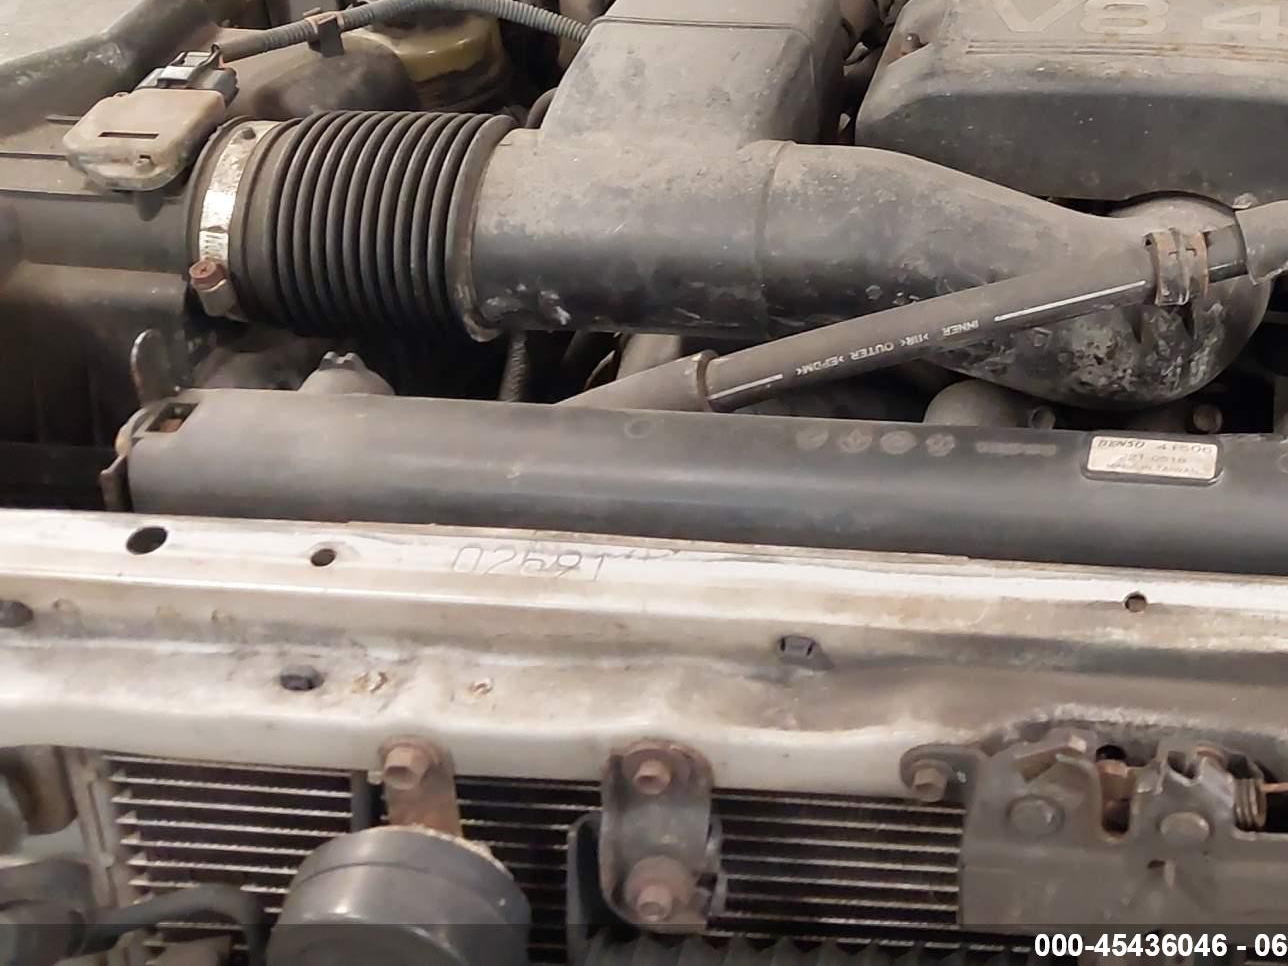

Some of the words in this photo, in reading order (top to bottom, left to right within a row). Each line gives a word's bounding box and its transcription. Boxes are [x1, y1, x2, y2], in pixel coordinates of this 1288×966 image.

[941, 319, 979, 337] INNER
[850, 342, 894, 361] OUTER
[1096, 438, 1146, 450] DENSO
